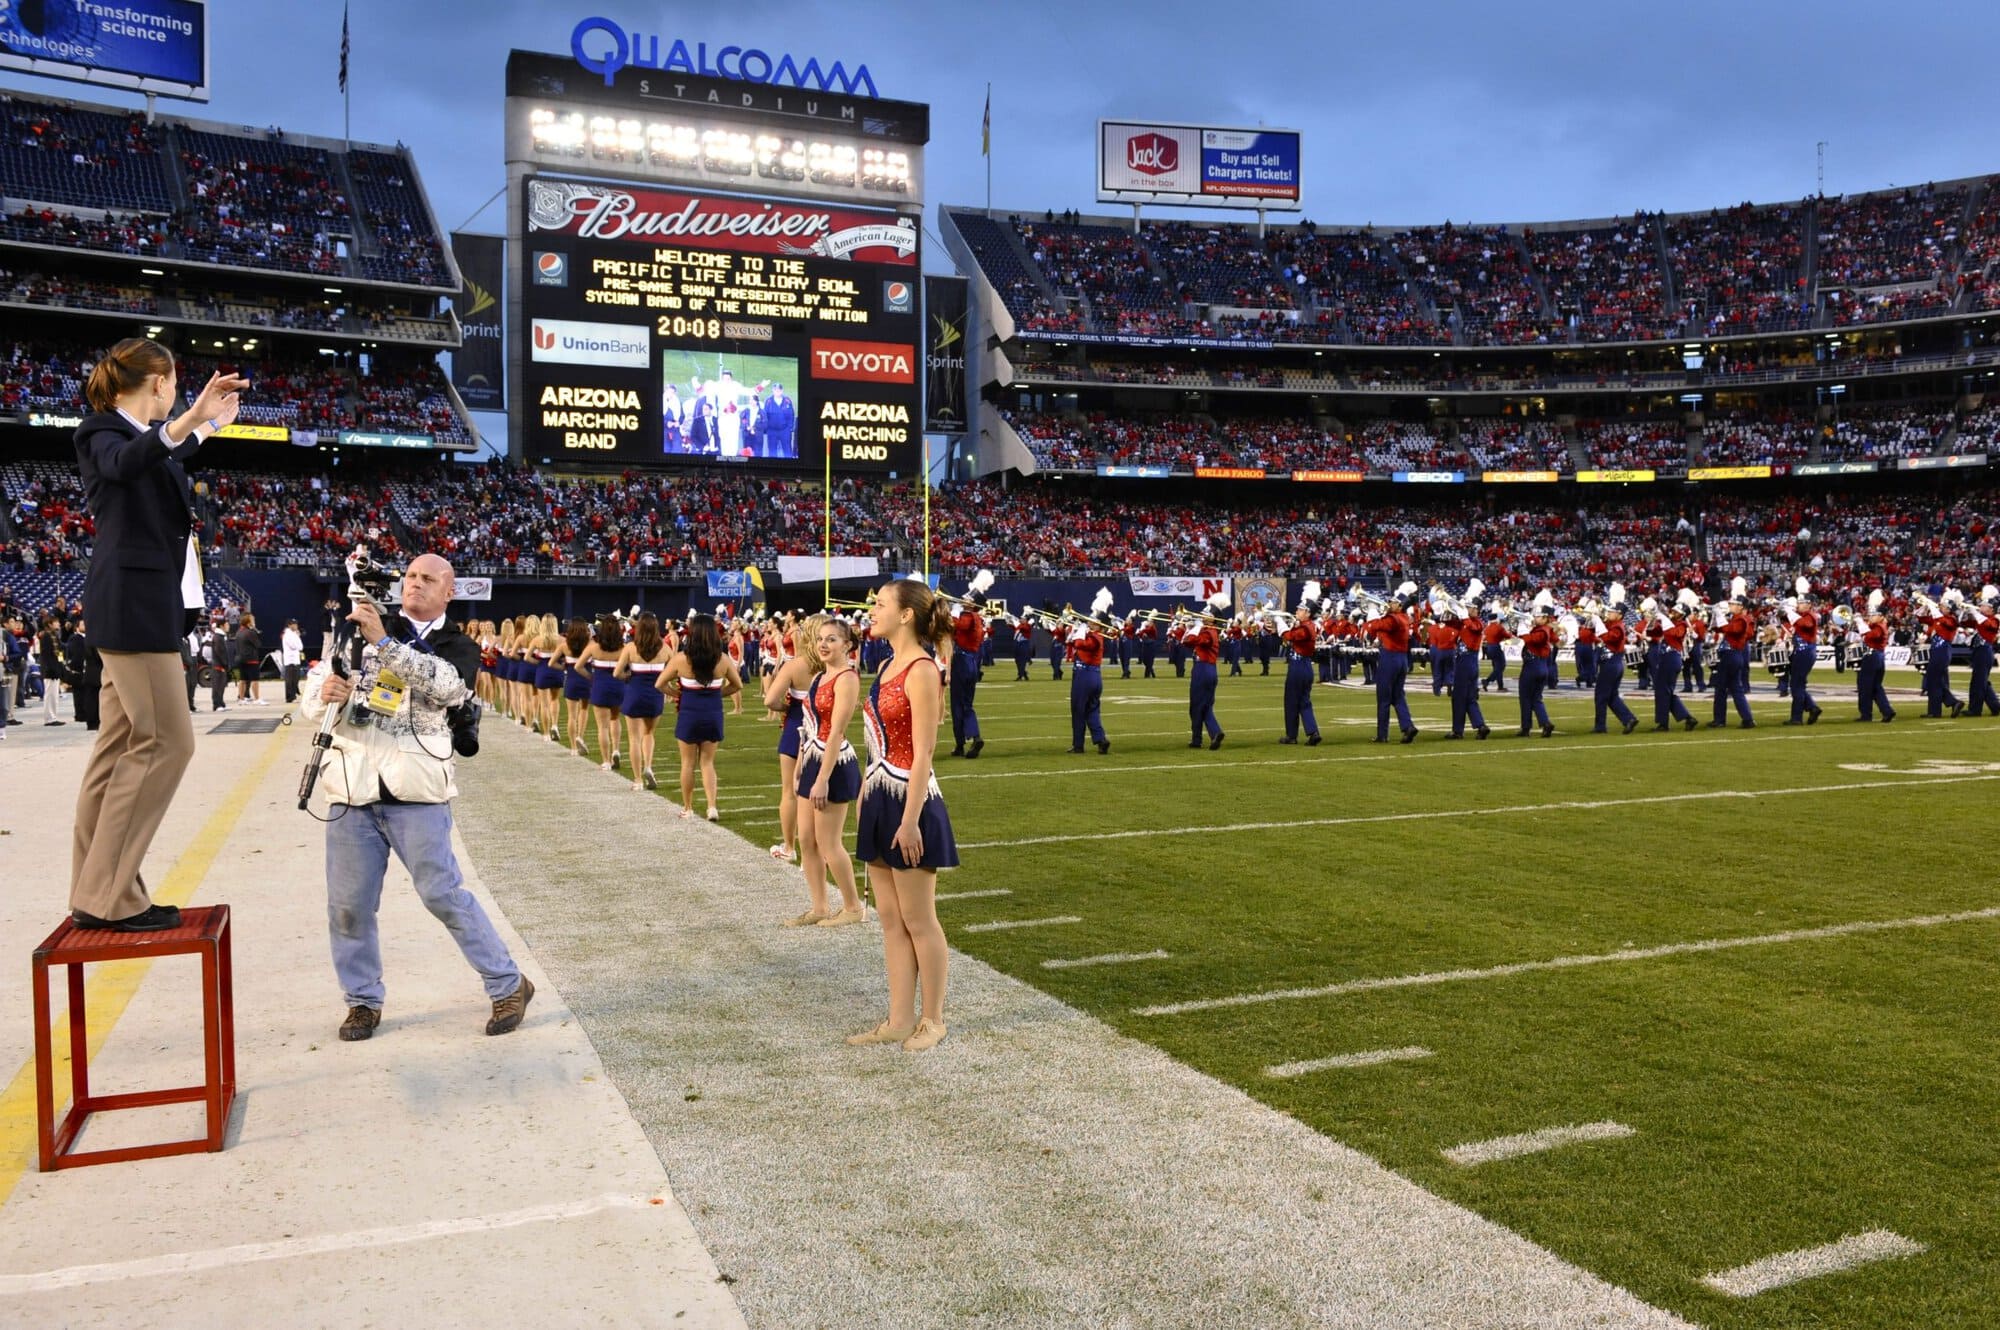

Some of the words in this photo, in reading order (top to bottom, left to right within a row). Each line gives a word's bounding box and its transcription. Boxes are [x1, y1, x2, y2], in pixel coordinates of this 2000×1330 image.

[75, 0, 192, 35] Transforming
[101, 18, 167, 42] science
[570, 16, 879, 99] QUALCOMM
[639, 80, 855, 119] STADIUM
[1128, 137, 1177, 170] Jack
[1220, 152, 1239, 166] Buy
[1241, 154, 1259, 166] and
[1261, 154, 1280, 167] Sell
[1208, 165, 1252, 180] Chargers
[1254, 168, 1292, 181] Tickets!
[565, 195, 830, 239] Budweiser
[833, 232, 880, 252] American
[883, 231, 913, 245] Lager
[655, 249, 731, 269] WELCOME
[741, 256, 764, 271] TO
[773, 259, 805, 275] THE
[593, 259, 673, 279] PACIFIC
[681, 267, 726, 284] LIFE
[735, 272, 809, 291] HOLIDAY
[818, 278, 860, 295] BOWL
[603, 277, 673, 294] PRE-GAME
[681, 284, 716, 297] SHOW
[722, 287, 797, 303] PRESENTED
[803, 293, 821, 306] BY
[828, 295, 852, 308] THE
[585, 289, 640, 306] SYCUAN
[646, 294, 682, 309] BAND
[689, 297, 707, 311] OF
[715, 299, 741, 314] THE
[747, 303, 813, 320] KUMEYAAY
[819, 308, 868, 323] NATION
[458, 320, 501, 339] print
[657, 315, 720, 339] 20:08
[725, 325, 772, 338] SYCUAN
[1052, 333, 1079, 341] CONDUCT
[562, 336, 648, 354] UnionBank
[816, 350, 910, 374] TOYOTA
[926, 353, 965, 370] Sprint
[540, 386, 642, 410] ARIZONA
[543, 410, 640, 431] MARCHING
[820, 401, 910, 424] ARIZONA
[354, 435, 382, 444] Degree
[400, 437, 428, 446] Degree
[564, 432, 617, 449] BAND
[823, 424, 907, 443] MARCHING
[842, 444, 888, 460] BAND
[1196, 468, 1230, 478] WELLS
[1232, 469, 1264, 479] FARGO
[1407, 472, 1453, 482] GEICO
[1492, 472, 1548, 482] CYMER
[709, 587, 738, 596] PACIFIC
[1202, 580, 1223, 600] N
